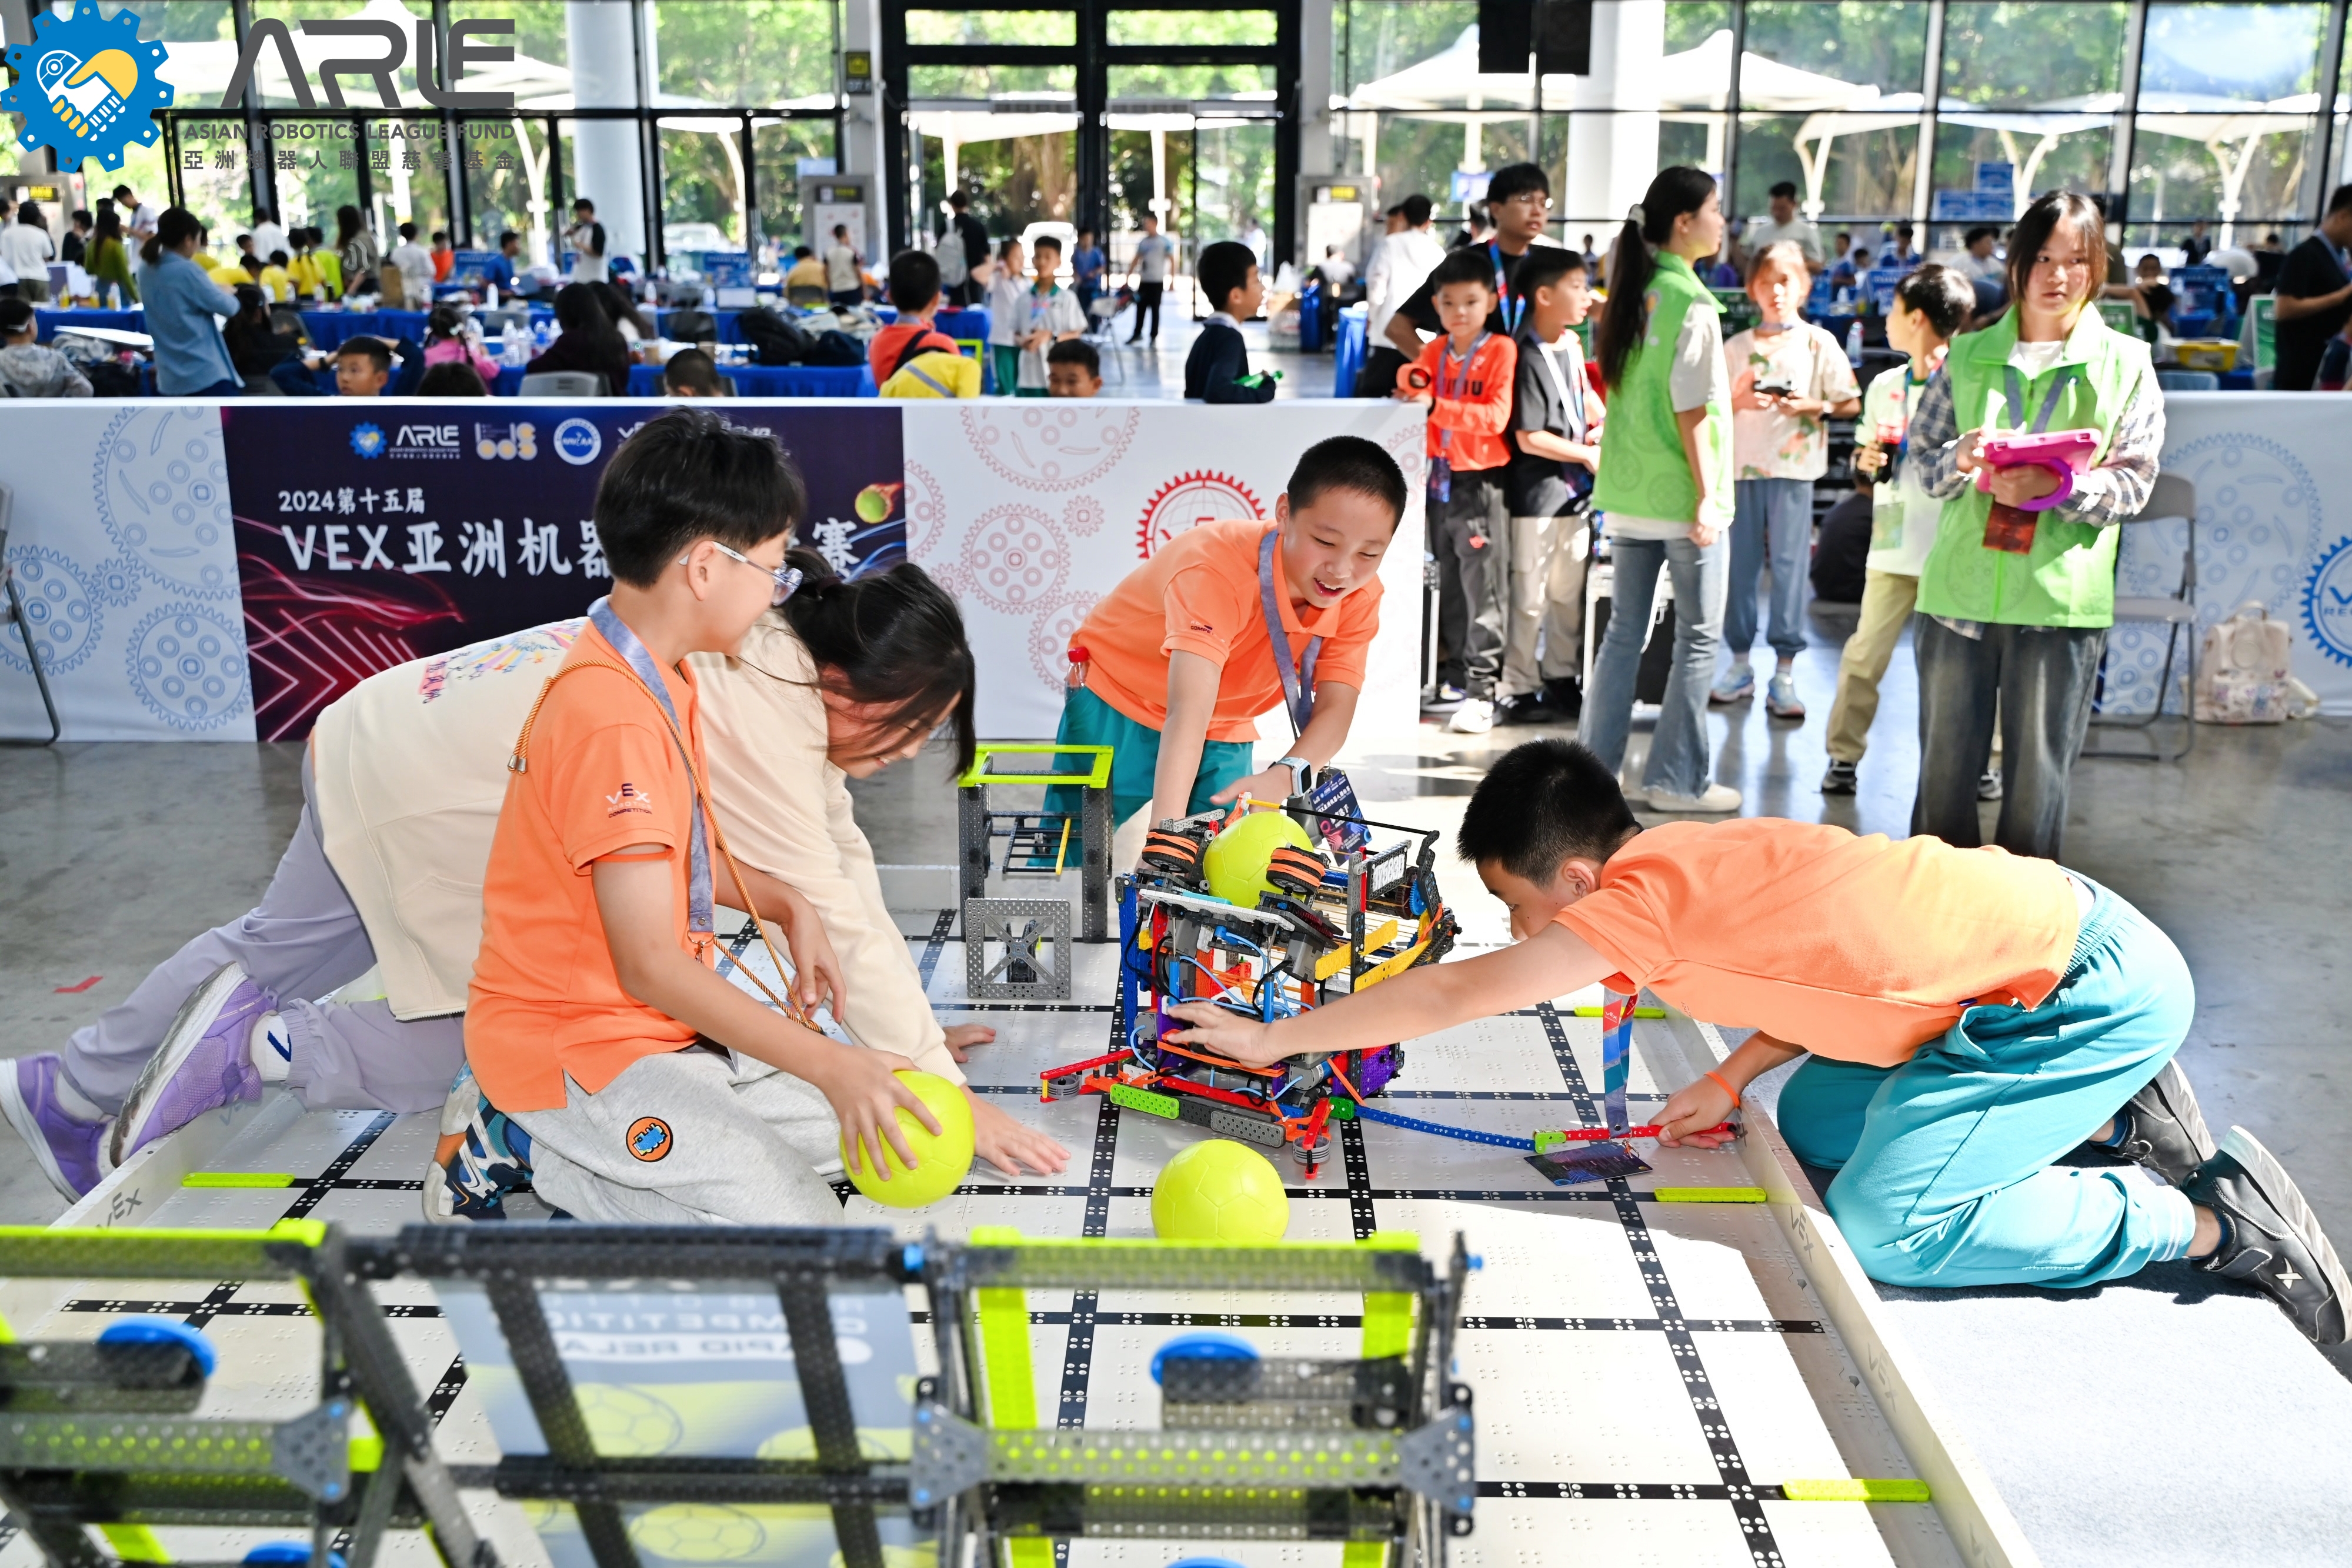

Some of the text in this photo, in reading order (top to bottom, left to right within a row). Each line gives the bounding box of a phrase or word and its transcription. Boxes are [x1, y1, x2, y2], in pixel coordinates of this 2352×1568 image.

[278, 487, 425, 515] 2024第十五届
[605, 783, 651, 804] VEX
[1605, 1010, 1618, 1020] VEX
[1790, 1205, 1814, 1263] VEX
[1867, 1341, 1899, 1413] VEX
